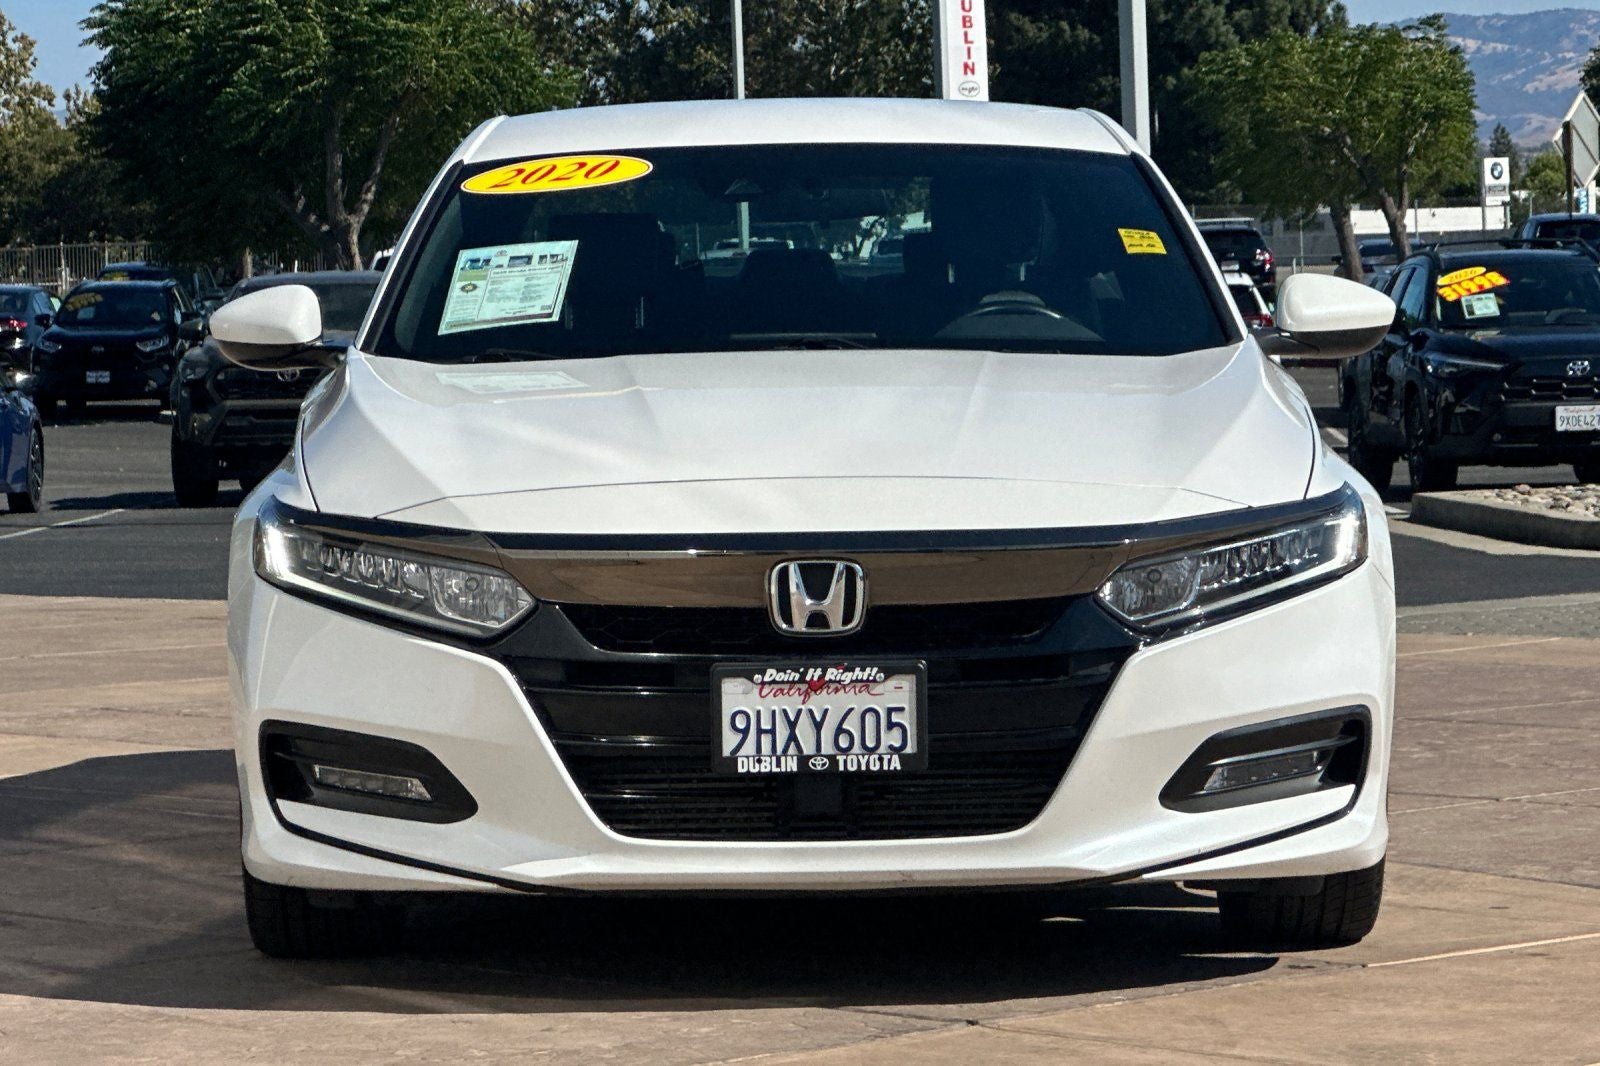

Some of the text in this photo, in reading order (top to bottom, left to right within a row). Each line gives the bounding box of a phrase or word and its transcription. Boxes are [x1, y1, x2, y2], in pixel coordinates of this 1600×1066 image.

[960, 0, 975, 76] UBLIN
[487, 159, 621, 189] 2020
[805, 667, 822, 681] It
[825, 666, 878, 685] Right!
[729, 706, 909, 755] 9HXY605
[737, 755, 798, 773] DUBLIN
[836, 754, 901, 772] TOYOTA
